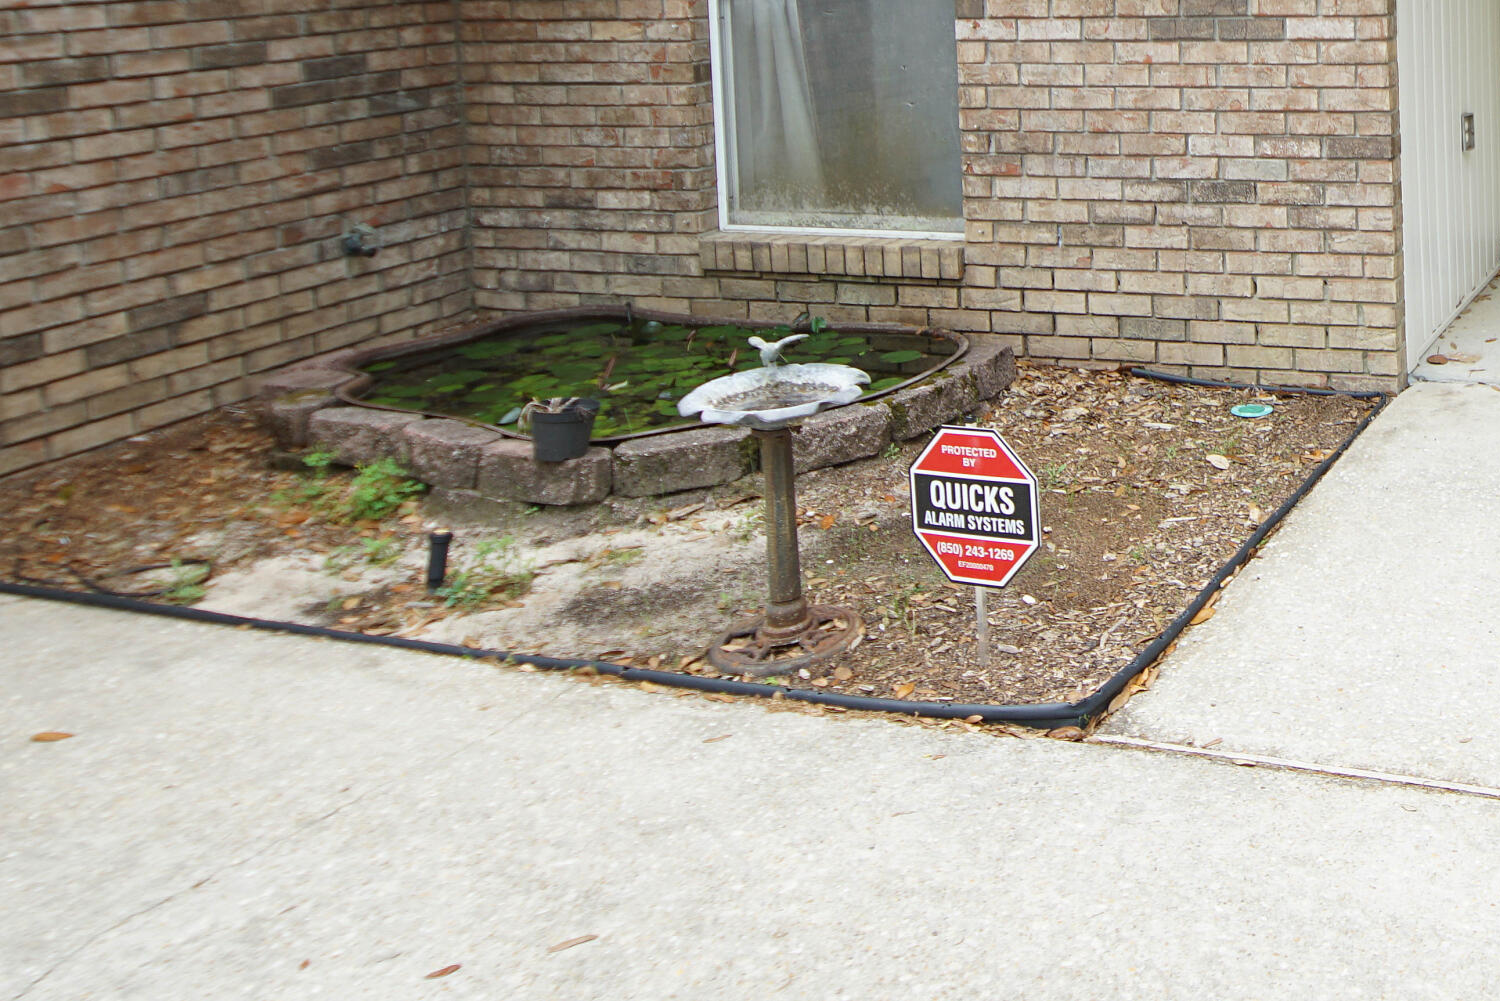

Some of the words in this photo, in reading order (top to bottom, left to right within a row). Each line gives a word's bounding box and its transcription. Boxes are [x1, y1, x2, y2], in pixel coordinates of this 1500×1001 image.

[941, 444, 997, 458] PROTECTED
[962, 457, 976, 467] BY
[929, 480, 1015, 515] QUICKS
[924, 510, 965, 529] ALARM
[967, 515, 1025, 535] SYSTEMS
[936, 541, 964, 558] (850)
[965, 545, 1015, 561] 243-1269
